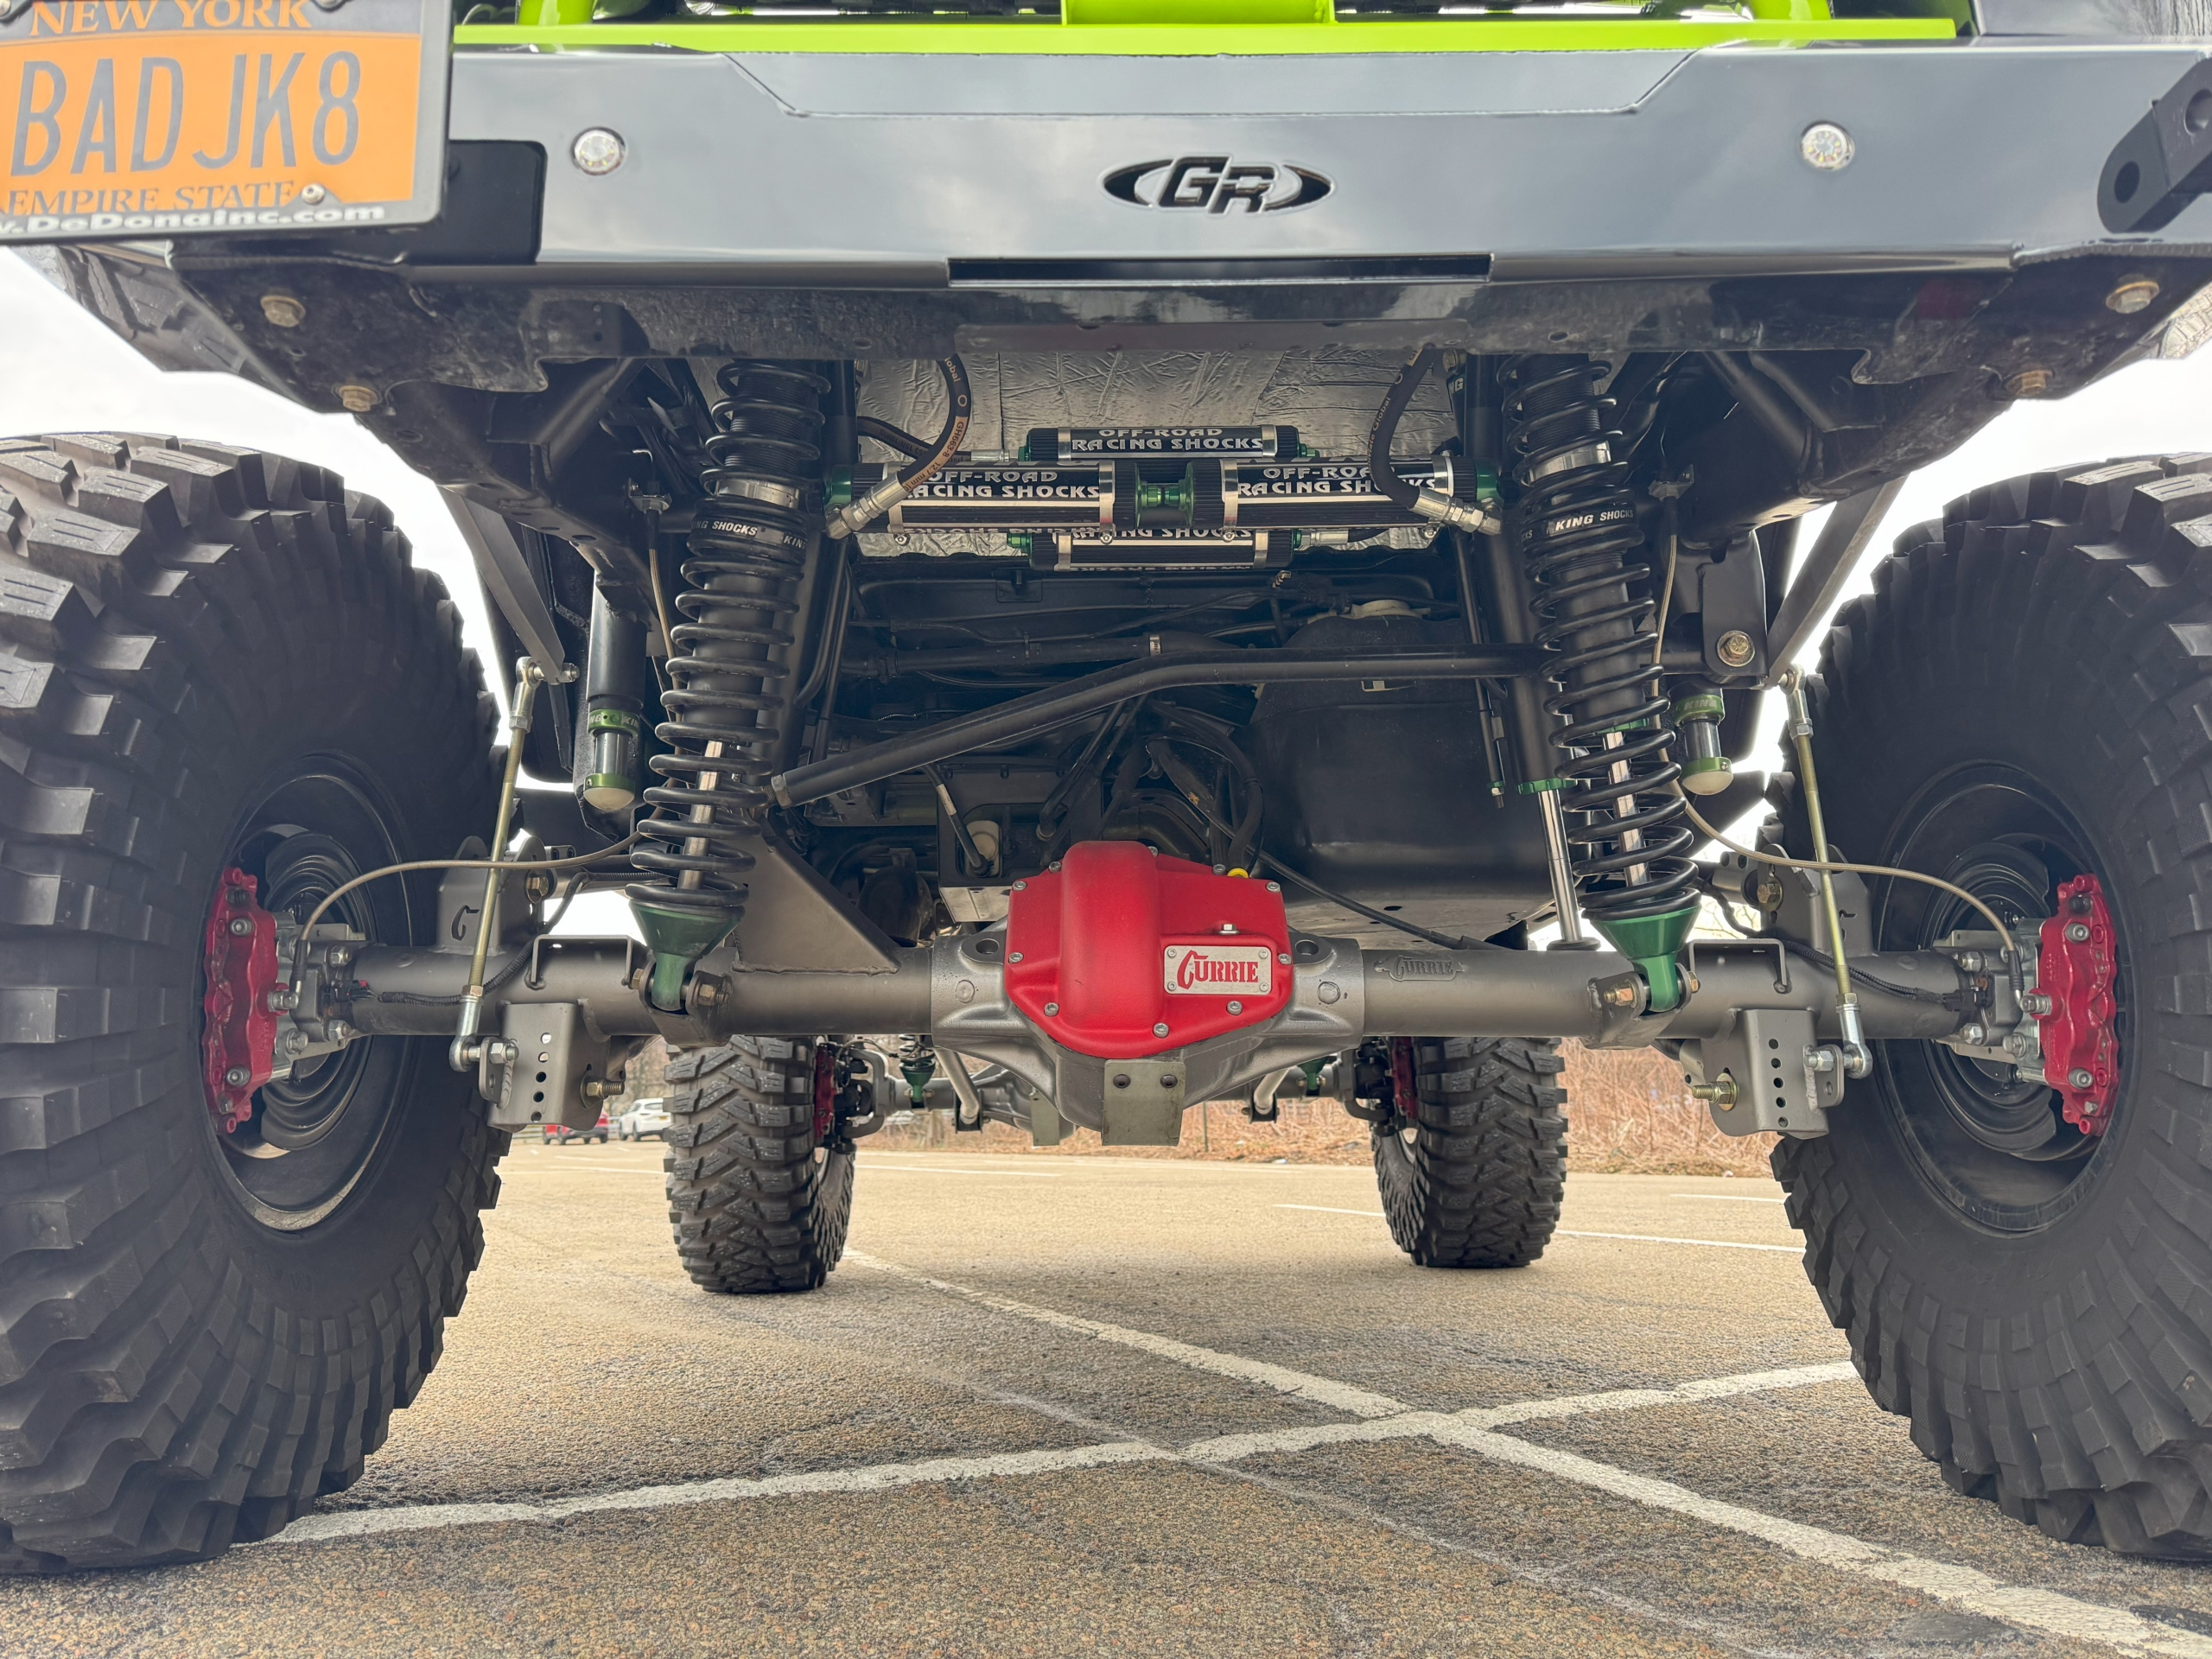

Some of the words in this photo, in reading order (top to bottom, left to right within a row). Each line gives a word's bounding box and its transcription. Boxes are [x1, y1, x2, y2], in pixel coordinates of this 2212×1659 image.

[29, 0, 159, 36] NEW
[181, 0, 313, 29] YORK
[10, 57, 184, 177] BAD
[192, 51, 361, 170] JK8
[1158, 156, 1275, 214] GR
[7, 188, 159, 216] EMPIRE
[174, 180, 296, 210] STATE
[944, 357, 962, 383] lobal
[1372, 397, 1391, 432] Global
[942, 421, 964, 458] GH663-8
[1098, 428, 1223, 437] OFF-ROAD
[1071, 438, 1162, 452] RACING
[1171, 437, 1263, 450] SHOCKS
[1263, 467, 1395, 480] OFF-ROA
[907, 485, 993, 499] ACING
[1001, 485, 1100, 499] SHOCKS
[1238, 480, 1331, 496] RACING
[1340, 478, 1435, 494] SHKS
[712, 520, 758, 536] SHOCKS
[1555, 514, 1594, 531] KING
[1599, 509, 1634, 522] SHOCKS
[1683, 699, 1718, 710] KING
[1176, 950, 1259, 990] CURRIE
[1392, 954, 1454, 977] CURRIE
